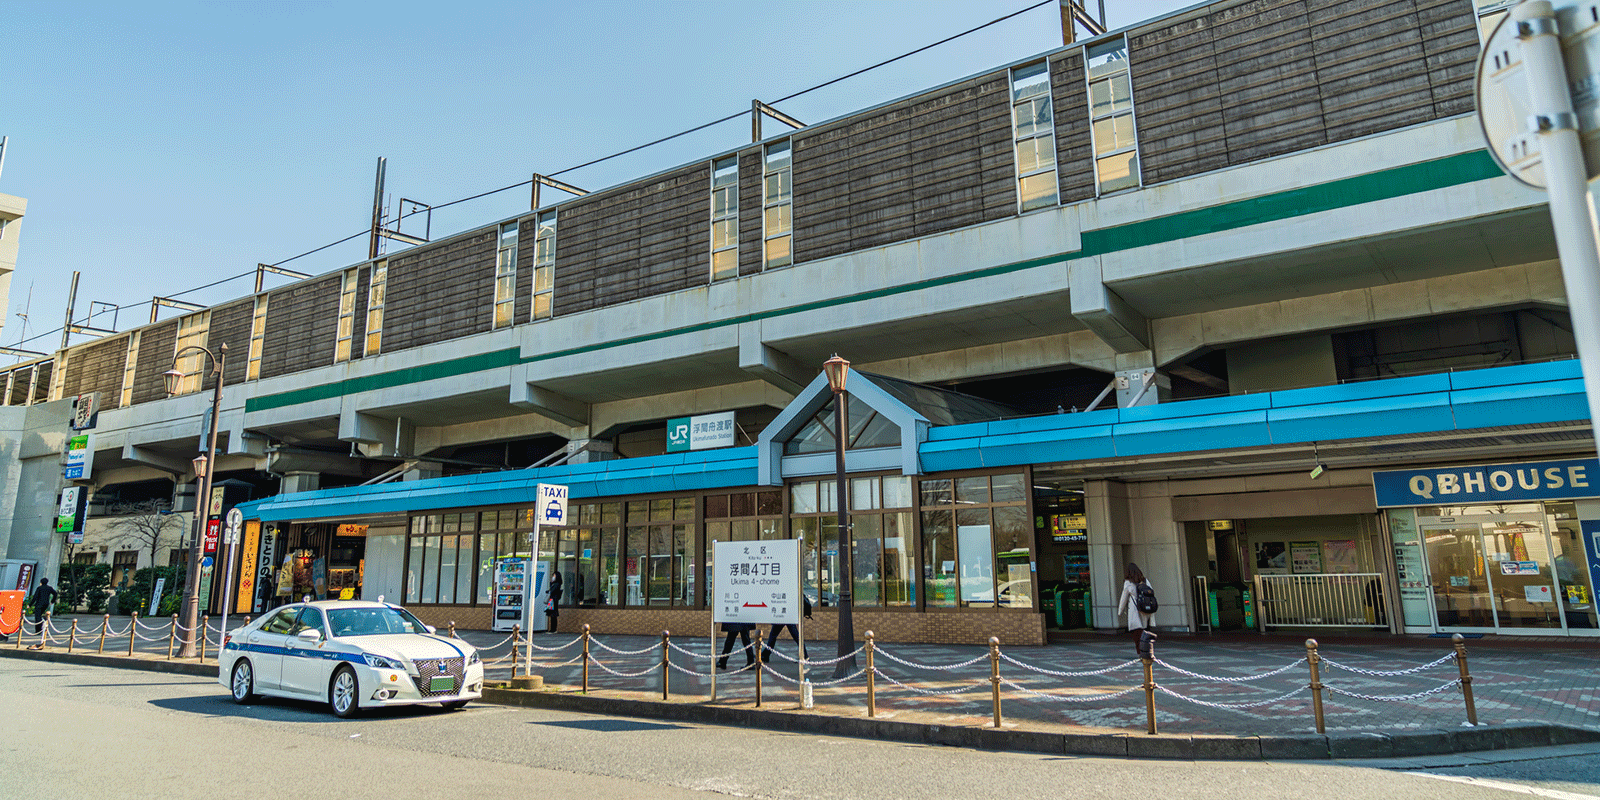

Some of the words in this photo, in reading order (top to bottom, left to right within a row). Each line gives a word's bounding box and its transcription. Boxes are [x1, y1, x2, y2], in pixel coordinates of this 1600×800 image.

[669, 424, 689, 441] JR
[692, 419, 733, 434] 浮間舟渡駅
[543, 486, 566, 499] TAXI
[258, 524, 275, 582] やきとりの
[729, 562, 781, 576] 浮間4丁目
